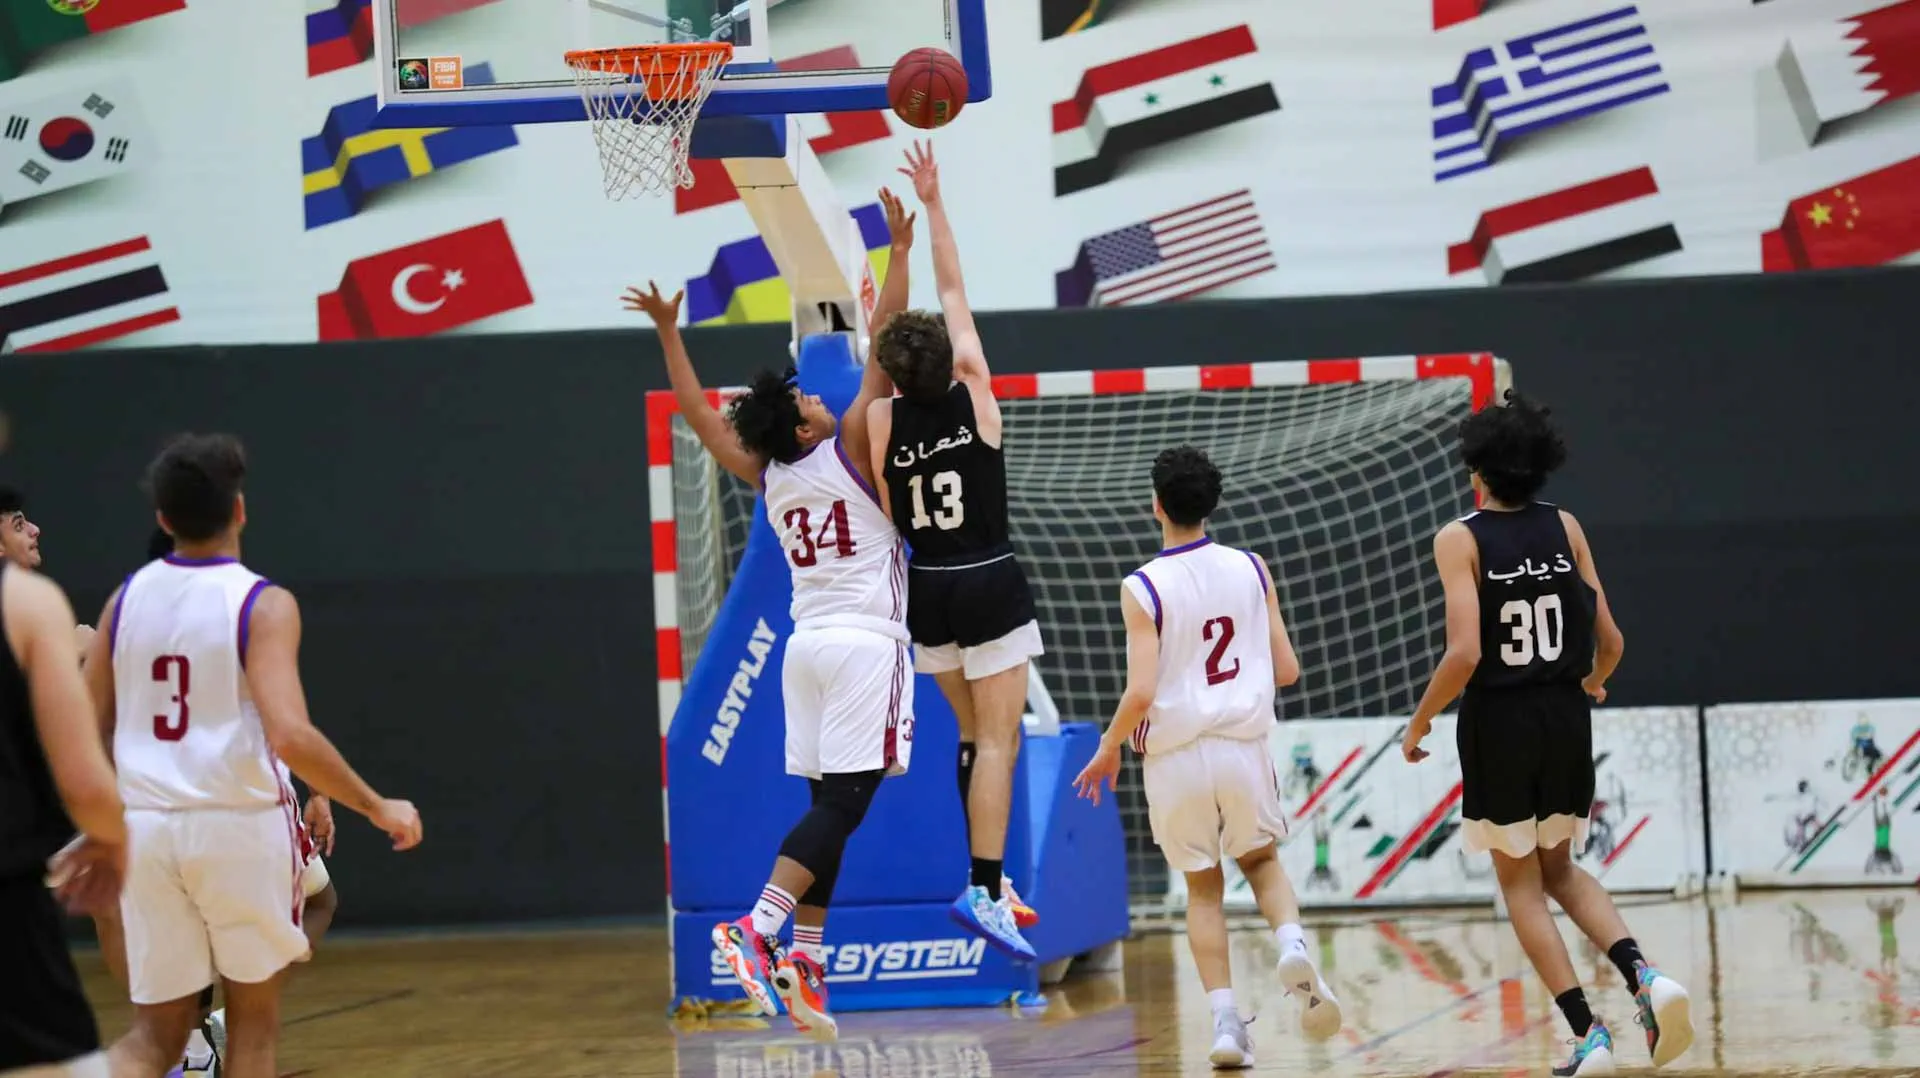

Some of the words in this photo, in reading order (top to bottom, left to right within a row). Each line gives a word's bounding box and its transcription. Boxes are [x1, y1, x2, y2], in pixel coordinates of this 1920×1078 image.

[783, 498, 857, 568] 34
[907, 470, 965, 531] 13
[1487, 553, 1572, 585] ذياب
[1202, 615, 1241, 687] 2
[1500, 593, 1564, 667] 30
[152, 654, 191, 742] 3
[701, 616, 777, 766] EASYPLAY
